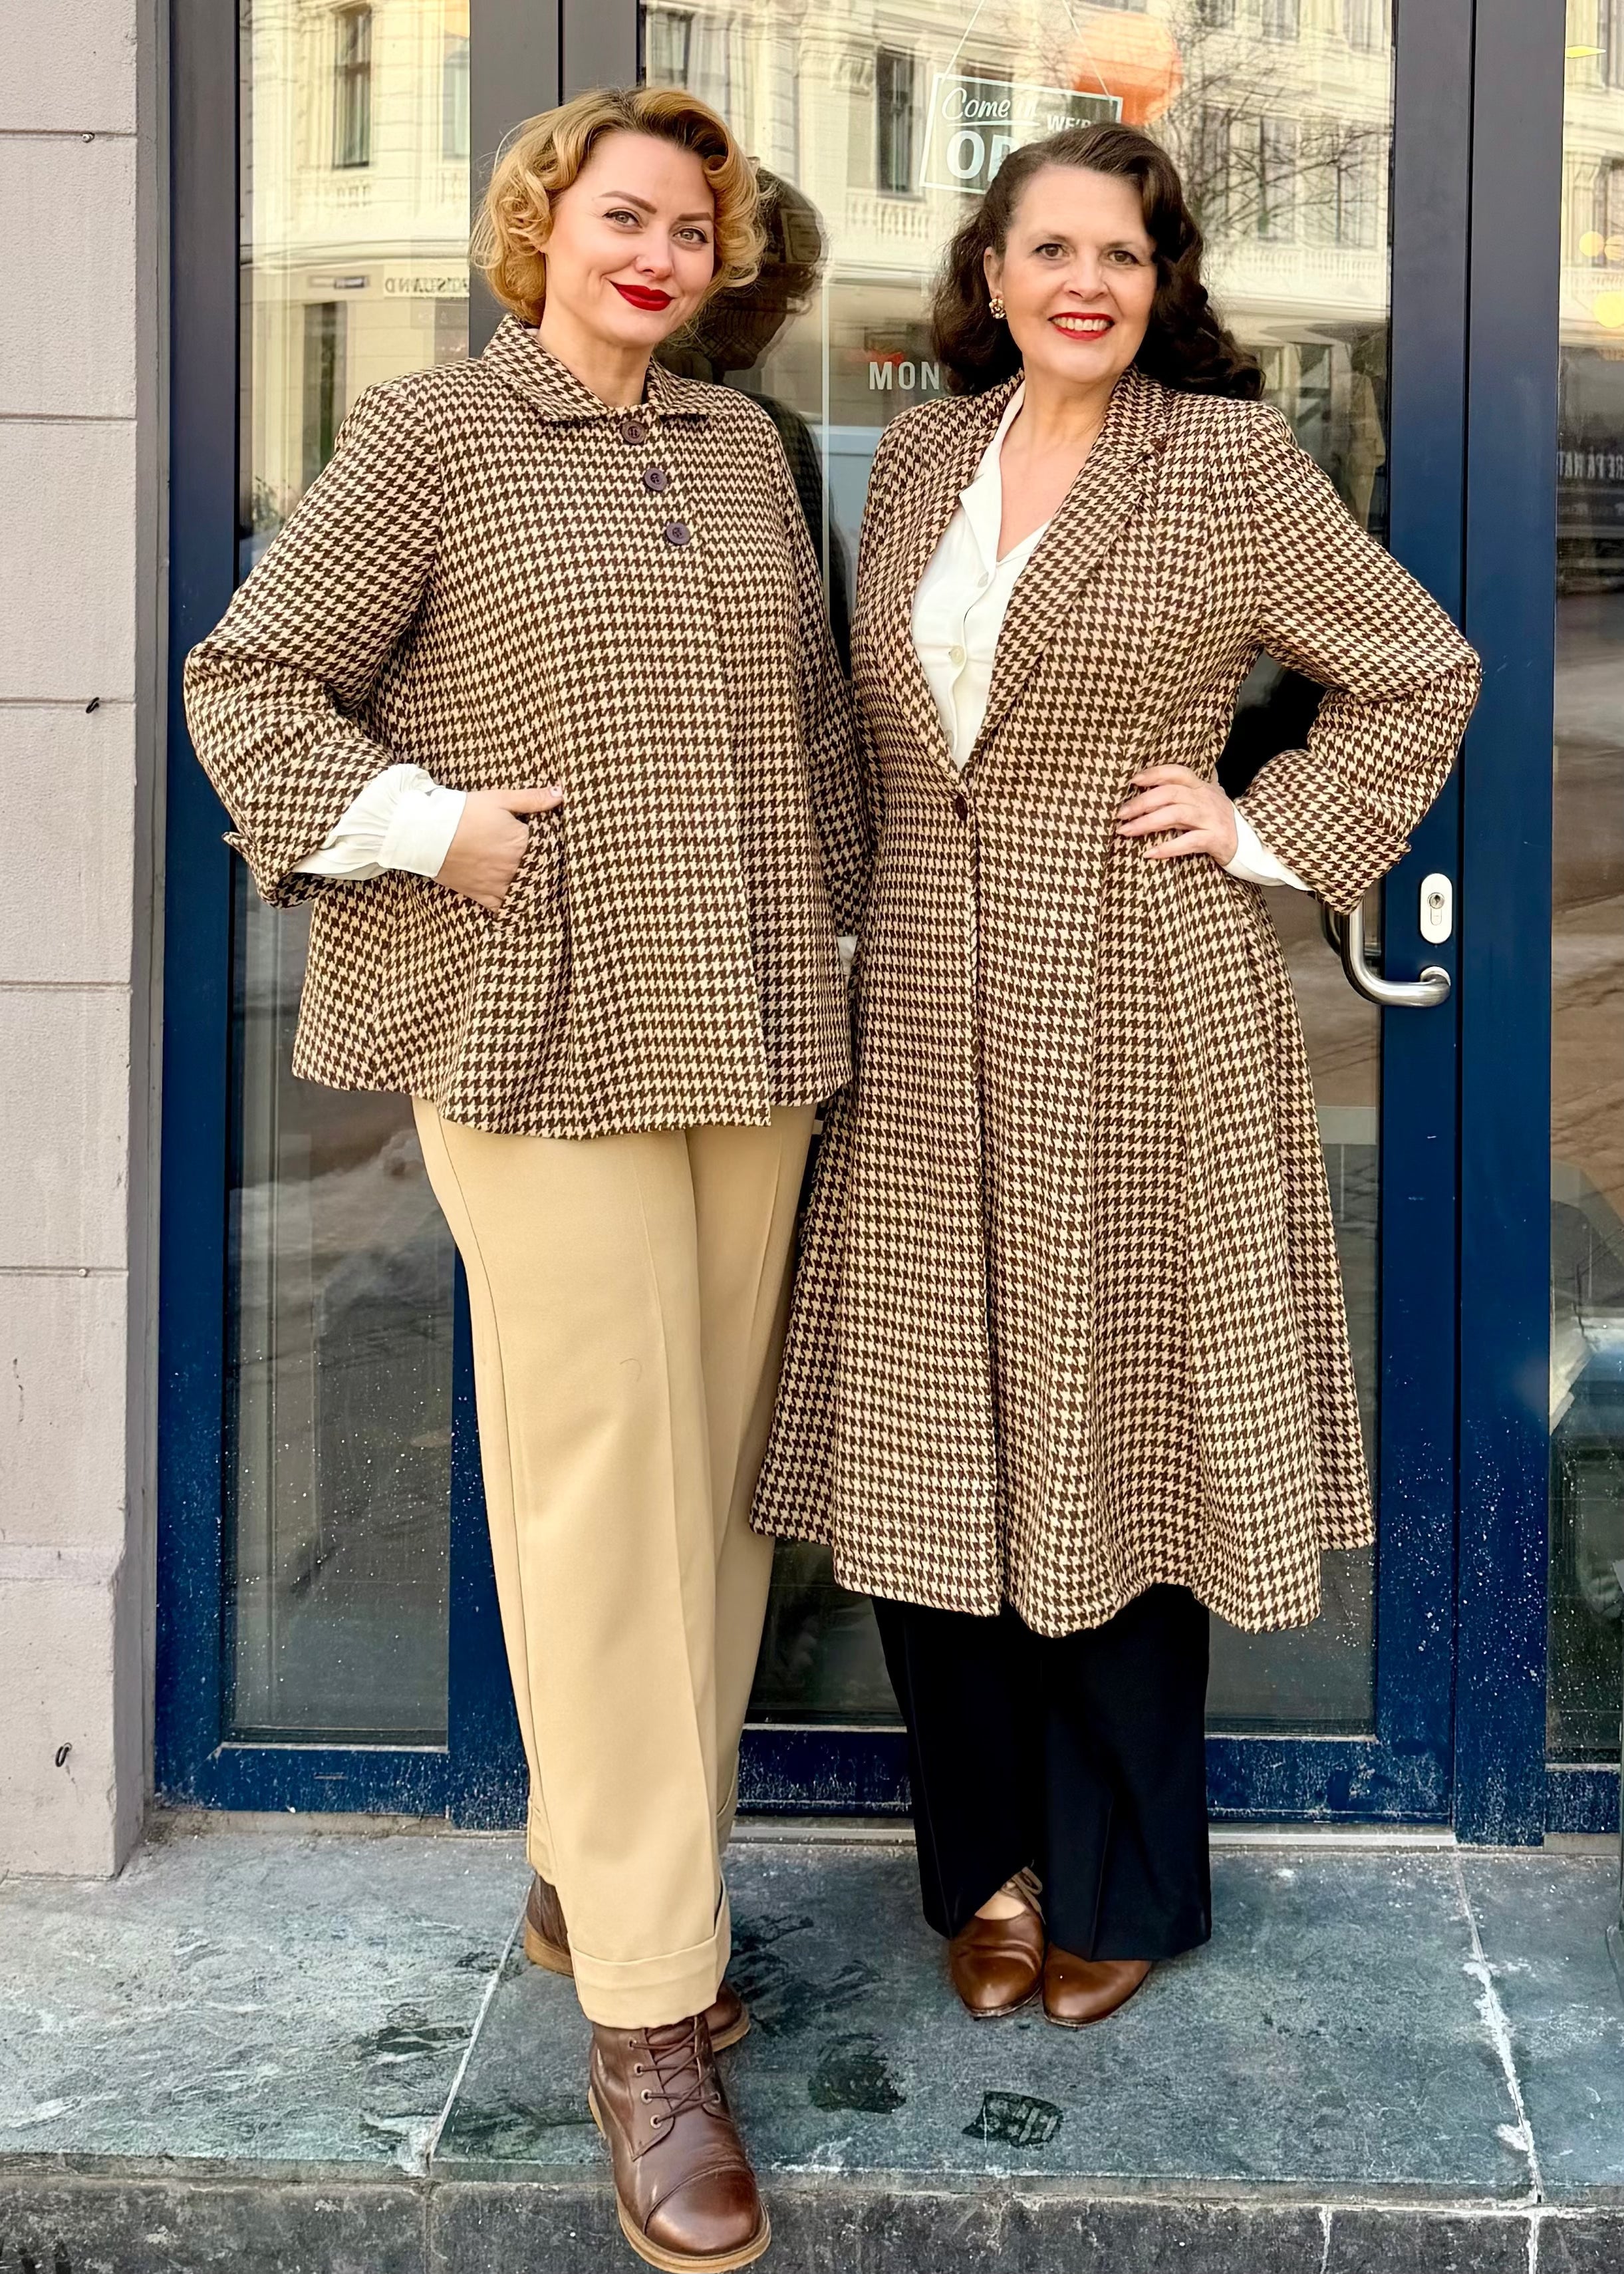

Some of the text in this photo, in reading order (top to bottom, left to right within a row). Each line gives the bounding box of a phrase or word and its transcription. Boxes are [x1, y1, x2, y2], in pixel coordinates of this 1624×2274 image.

[941, 86, 1012, 121] Come
[1047, 114, 1093, 130] WE'R
[946, 130, 1021, 182] OP
[869, 360, 940, 390] MON
